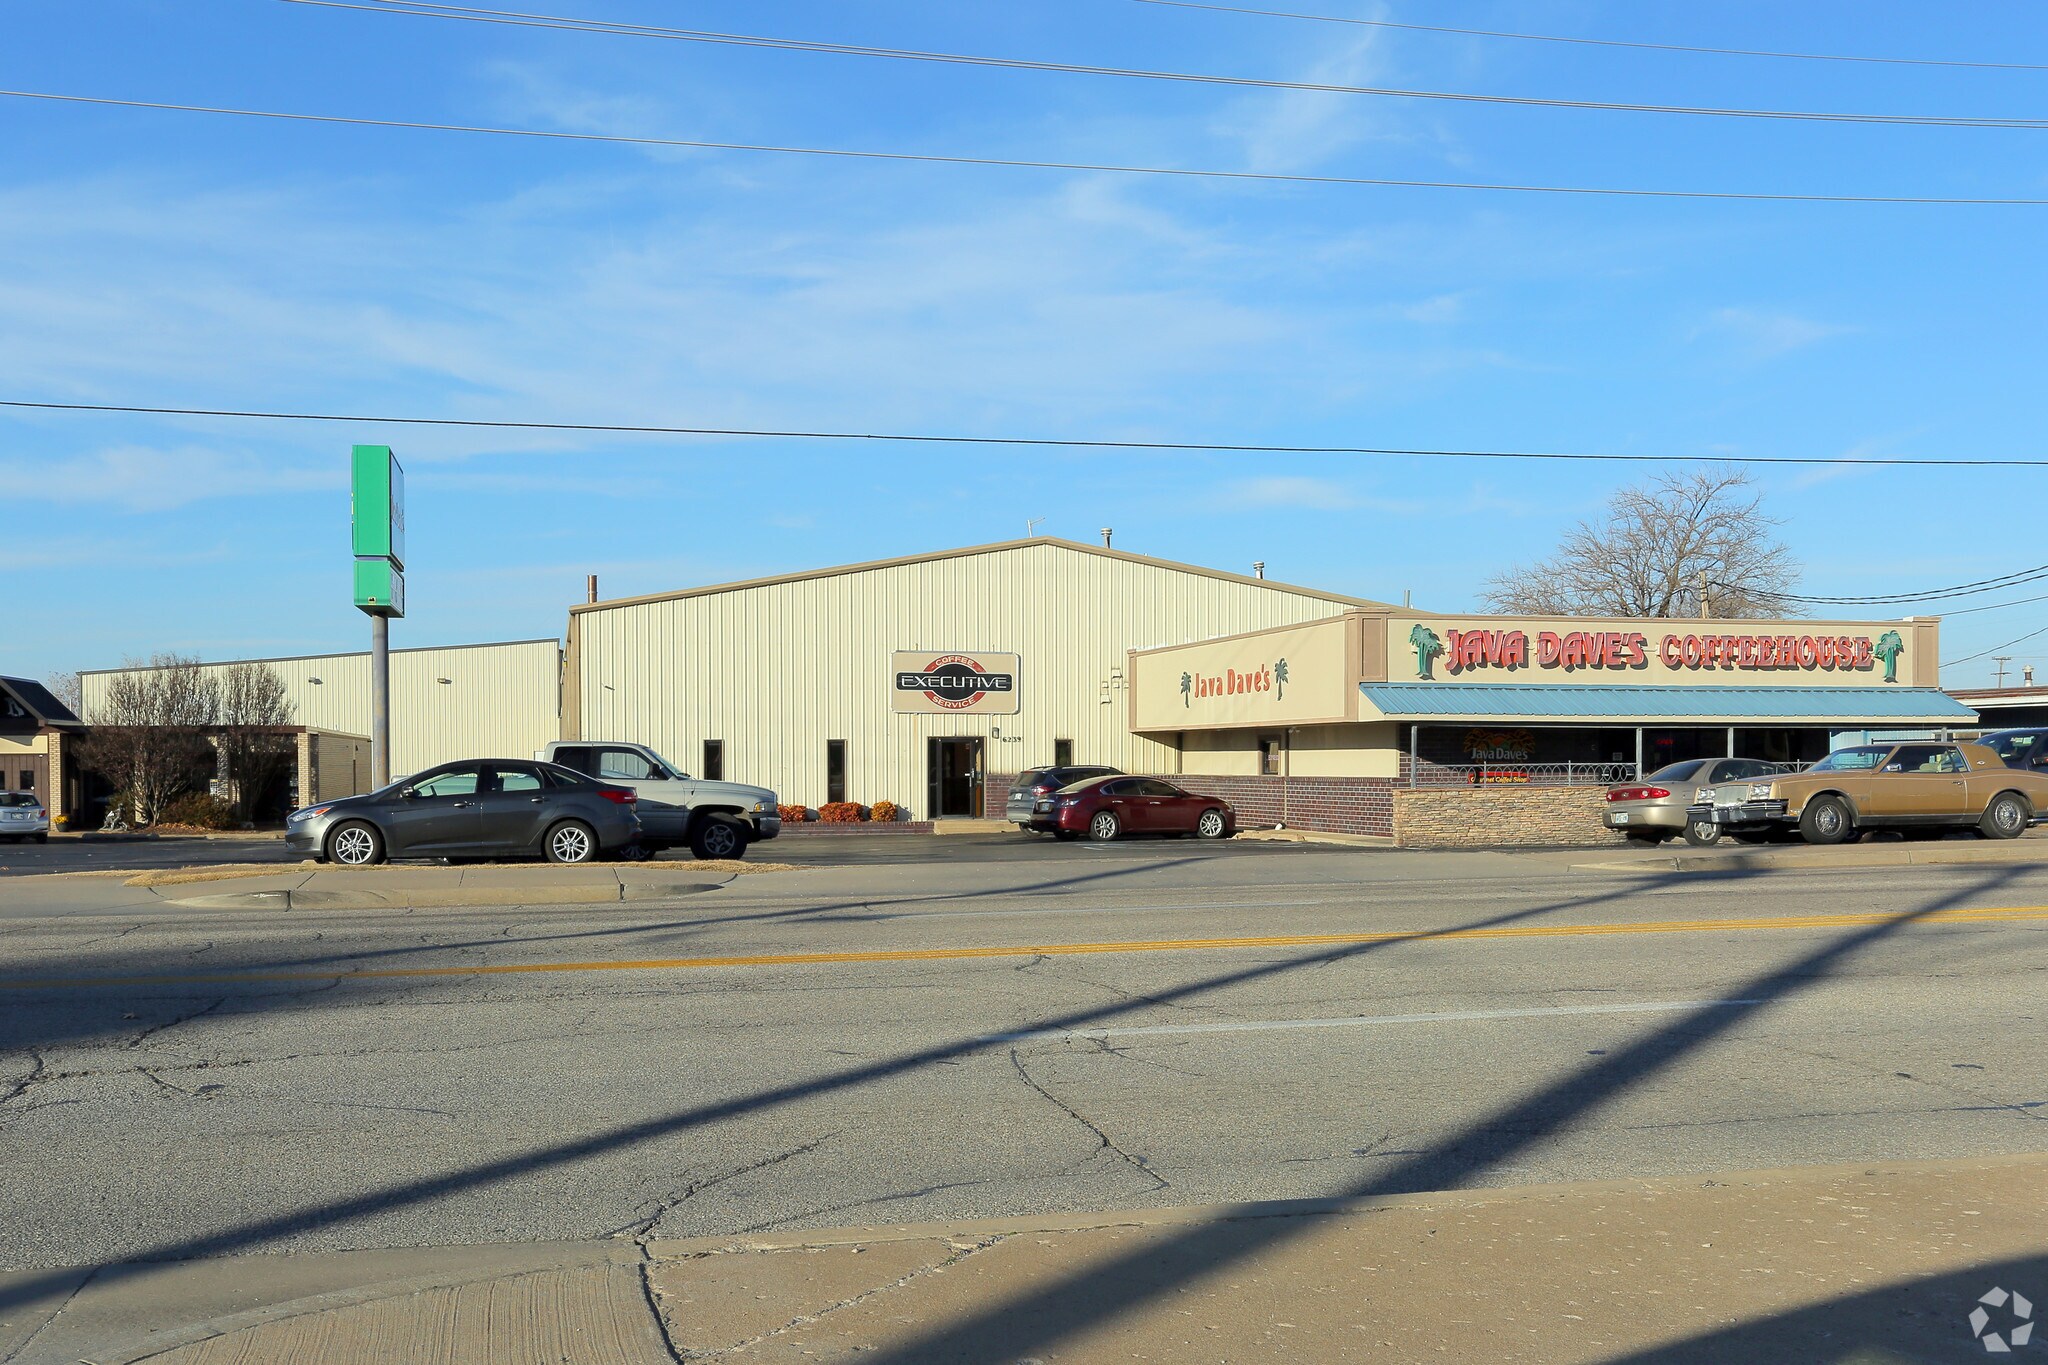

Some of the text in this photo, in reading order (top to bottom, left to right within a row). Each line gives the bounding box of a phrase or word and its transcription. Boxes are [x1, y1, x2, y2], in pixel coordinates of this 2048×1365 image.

[1444, 629, 1873, 671] JAVA DAVE'S COFFEEHOUSE
[935, 655, 974, 667] COFFEE
[901, 675, 1007, 689] EXECUTIVE
[1194, 664, 1270, 699] Java Dave's
[932, 696, 975, 709] SERVICE
[1471, 748, 1494, 760] Java
